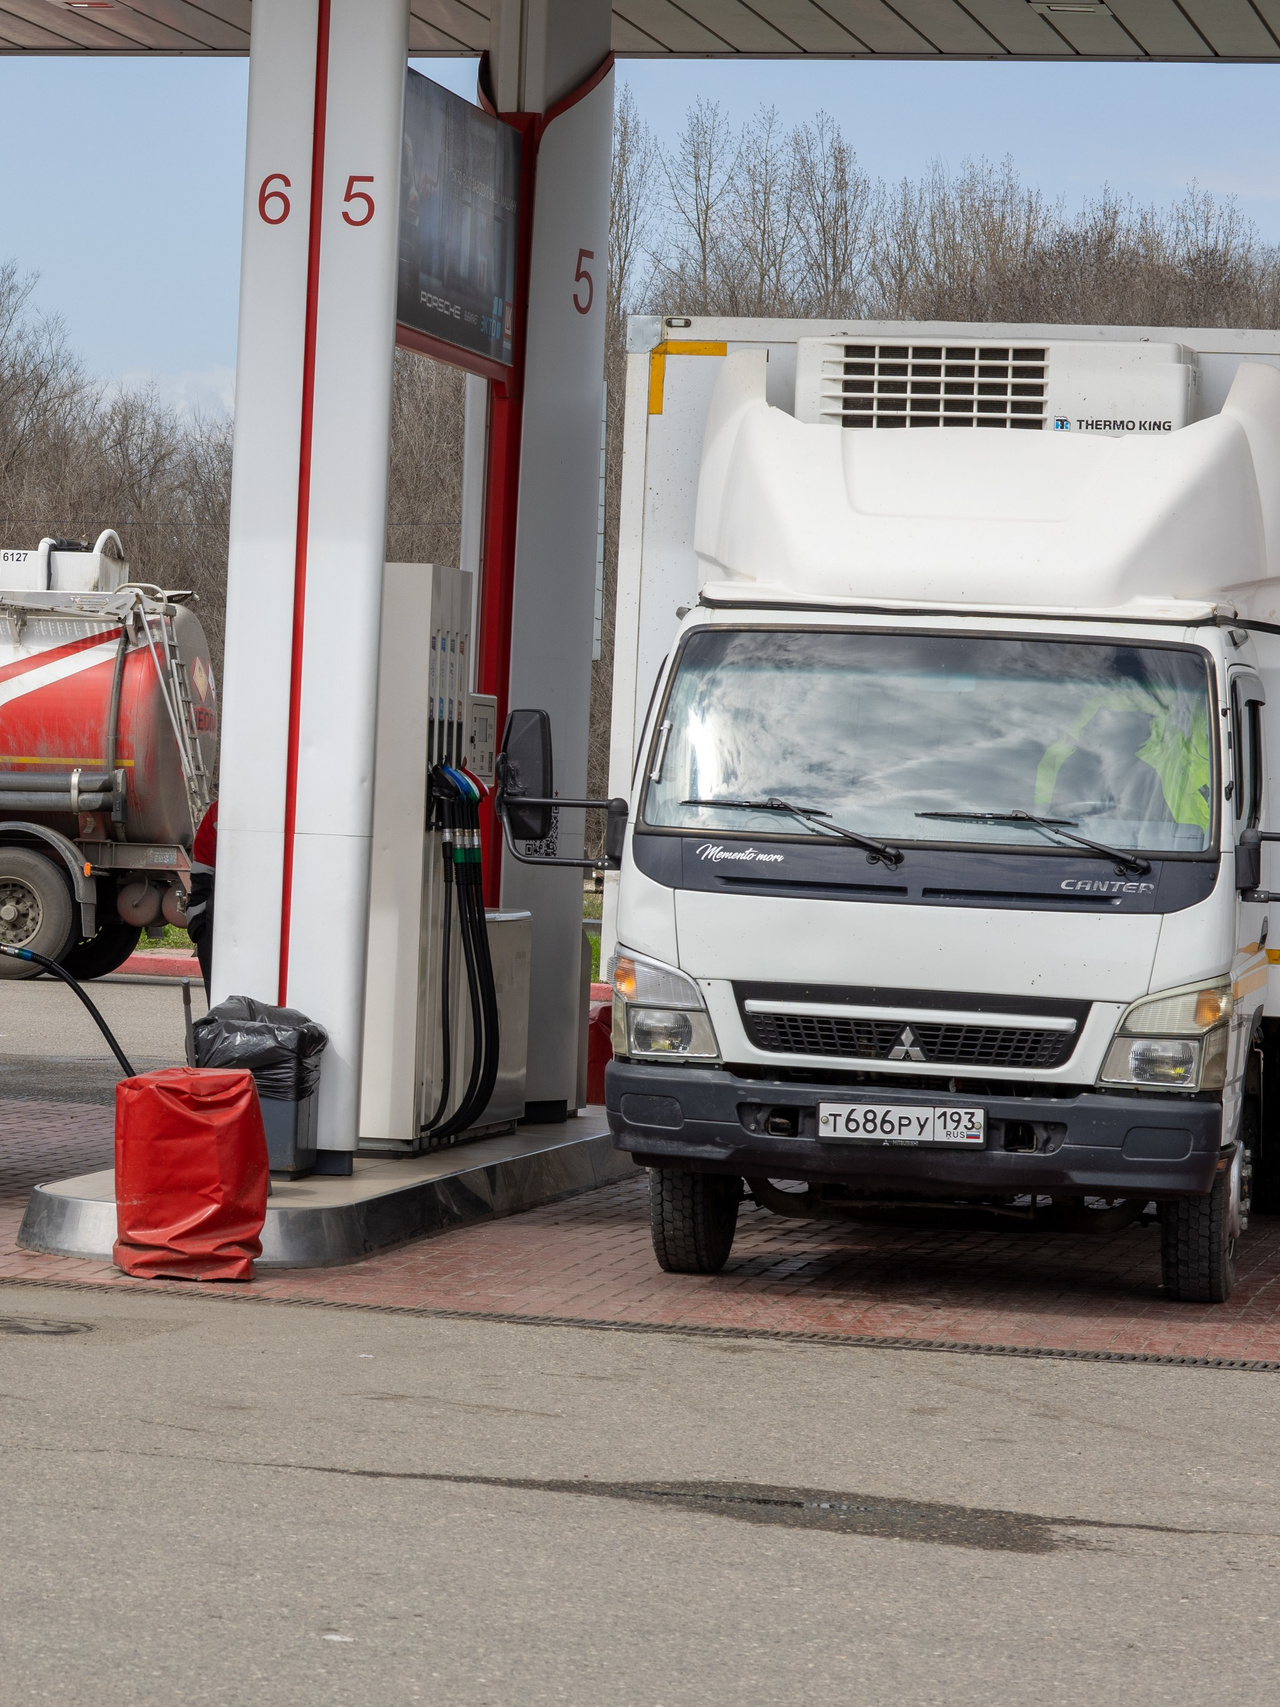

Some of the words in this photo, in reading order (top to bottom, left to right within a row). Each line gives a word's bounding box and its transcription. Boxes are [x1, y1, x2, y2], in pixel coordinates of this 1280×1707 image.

[258, 173, 291, 225] 6
[341, 175, 375, 226] 5
[573, 248, 594, 315] 5
[420, 290, 461, 320] PORSCHE
[1076, 419, 1136, 431] THERMO
[1138, 420, 1172, 431] KING
[2, 552, 29, 562] 6127
[696, 843, 758, 862] Memento
[1060, 879, 1155, 894] CANTER
[828, 1109, 930, 1136] Т686РУ
[937, 1111, 976, 1131] 193
[946, 1131, 966, 1139] RUS
